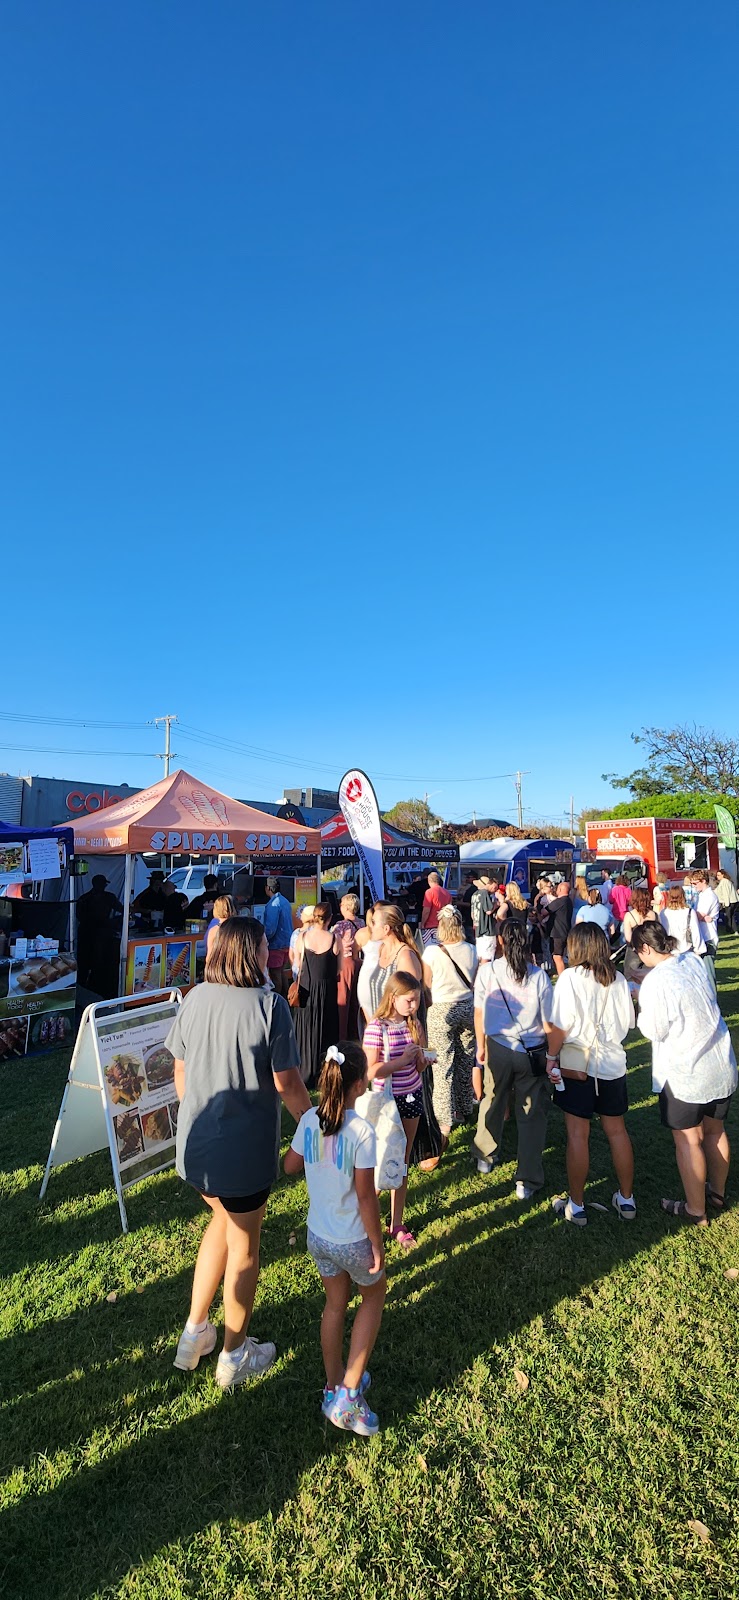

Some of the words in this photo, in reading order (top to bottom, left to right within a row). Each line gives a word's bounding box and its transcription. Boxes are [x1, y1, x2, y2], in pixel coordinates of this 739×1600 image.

[150, 831, 234, 850] SPIRAL
[245, 833, 308, 851] SPUDS
[338, 846, 355, 857] FOOD
[398, 848, 406, 857] IN
[407, 847, 420, 857] THE
[421, 848, 434, 857] DOG
[435, 849, 456, 858] HOUSE?
